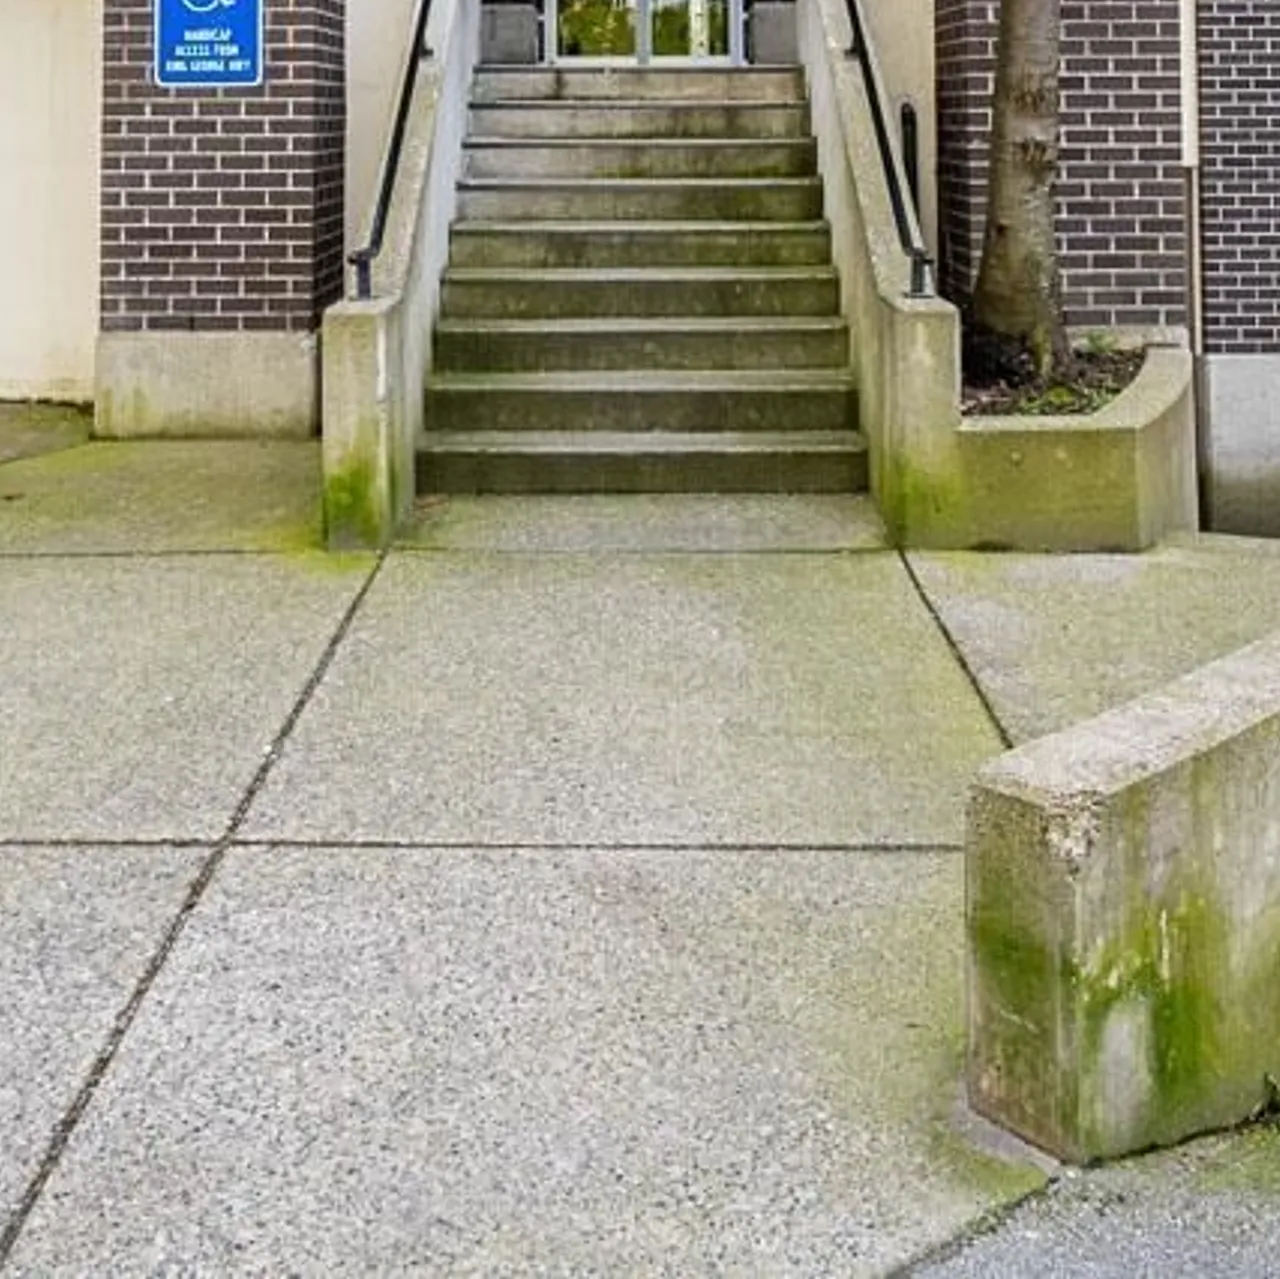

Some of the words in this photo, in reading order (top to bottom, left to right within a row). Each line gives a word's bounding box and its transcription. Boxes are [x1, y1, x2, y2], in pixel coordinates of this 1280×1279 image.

[184, 27, 233, 41] HANDICAP
[175, 44, 210, 56] ACCESS
[214, 44, 239, 56] FROM
